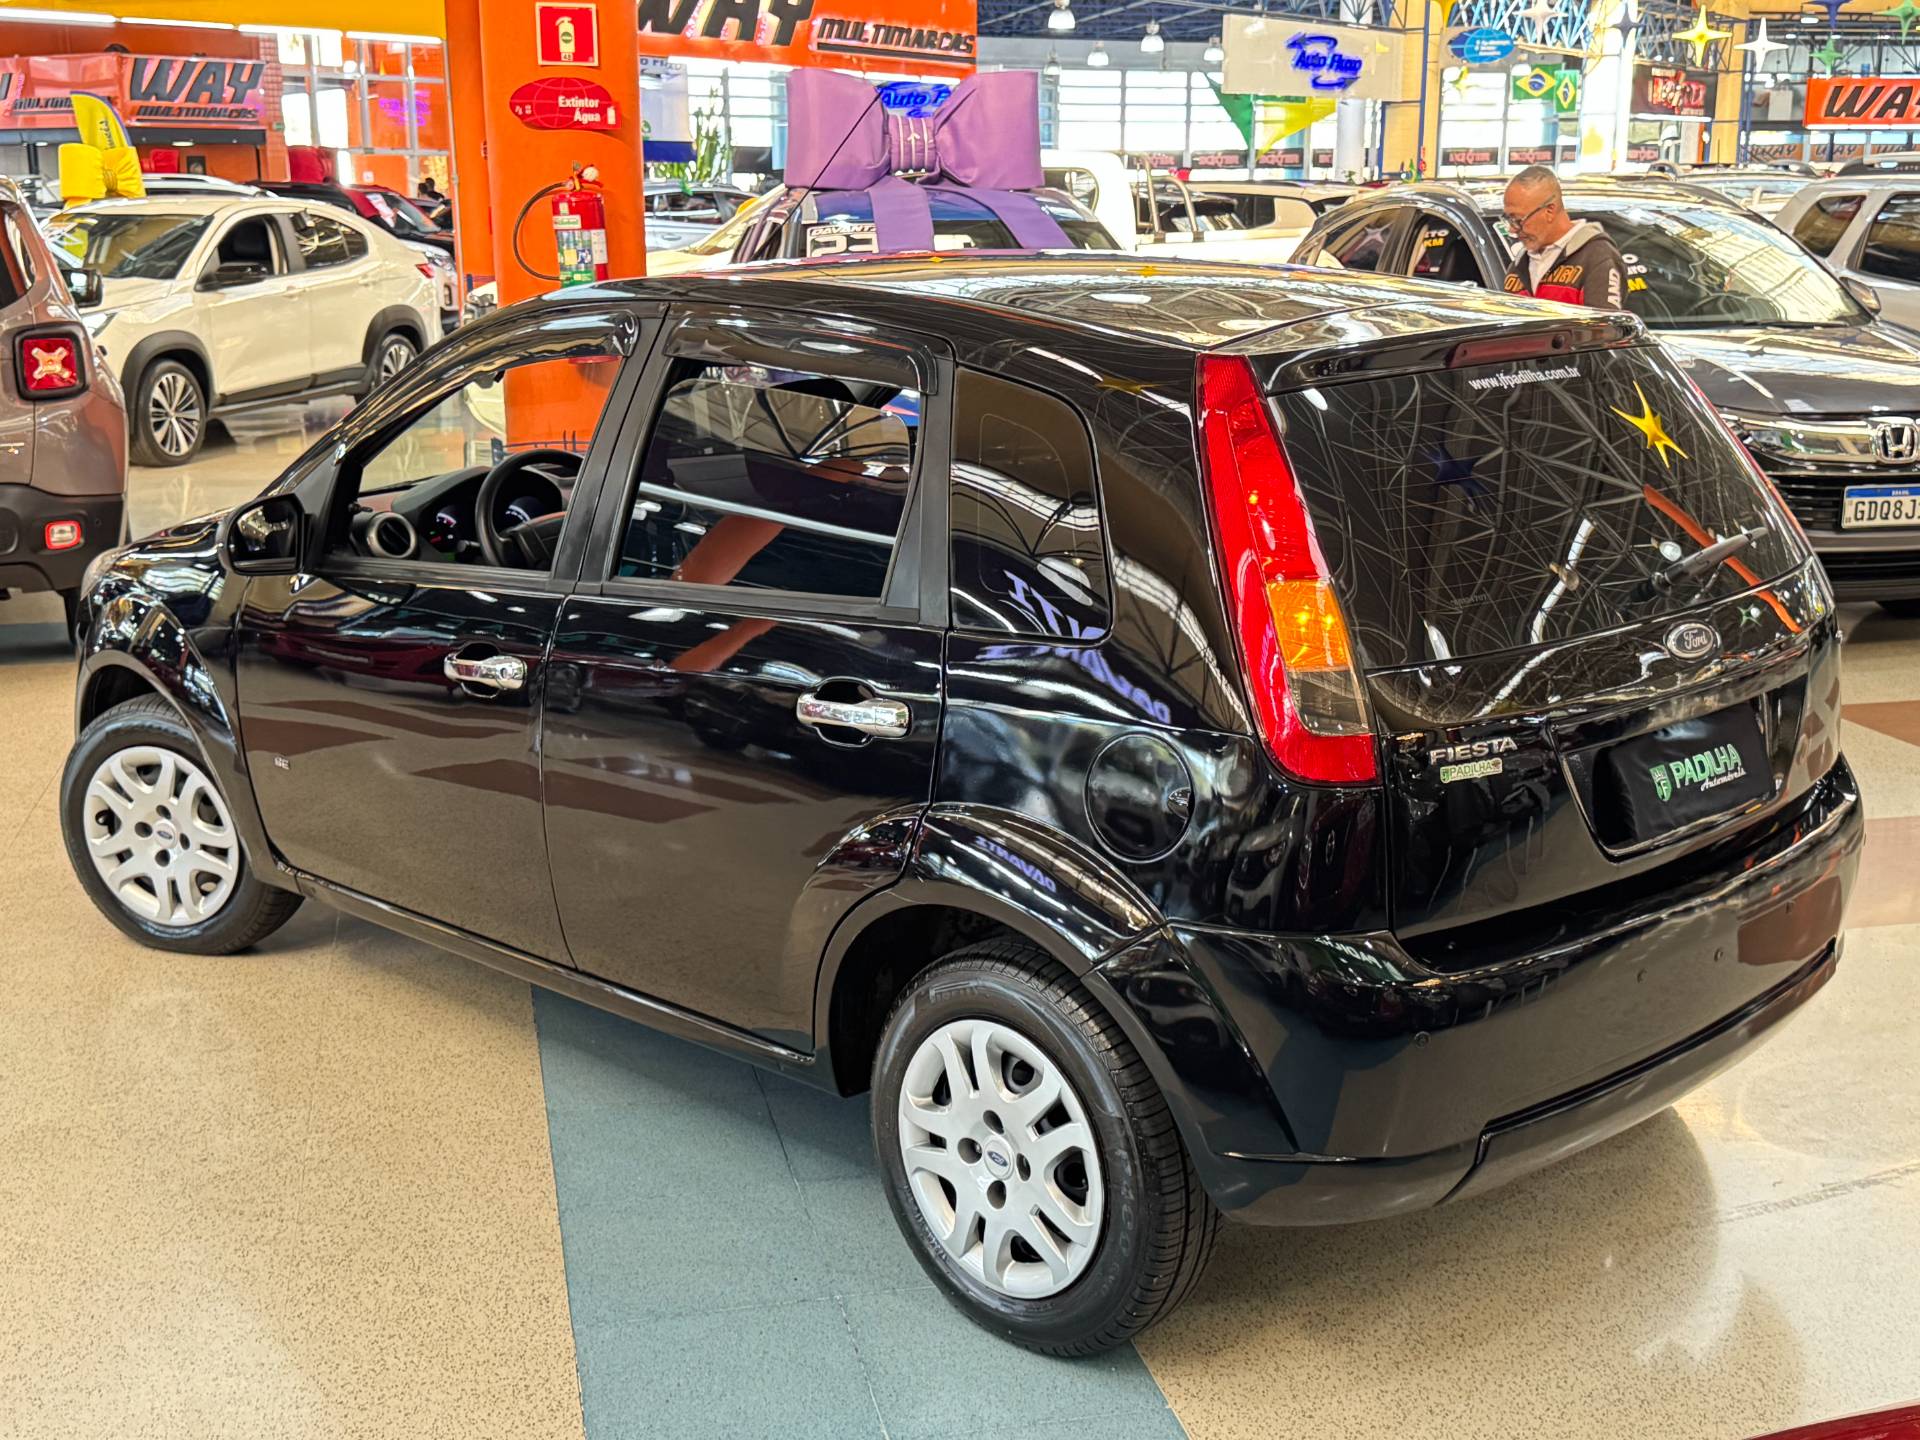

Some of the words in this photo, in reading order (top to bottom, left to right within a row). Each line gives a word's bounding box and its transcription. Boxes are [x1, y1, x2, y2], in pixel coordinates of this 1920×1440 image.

[817, 17, 975, 54] MULTIMARCAS
[130, 58, 265, 104] WAY
[558, 95, 600, 108] Extintor
[882, 90, 931, 109] Auto
[1823, 85, 1920, 118] WA
[573, 107, 601, 124] Água
[1468, 365, 1582, 390] www.jfpadilha.com.br
[1854, 498, 1920, 522] GDQ8J
[1682, 629, 1708, 650] Ford
[1429, 736, 1518, 766] FIESTA
[1449, 761, 1493, 777] PADILHA
[1669, 743, 1743, 789] PADILHA
